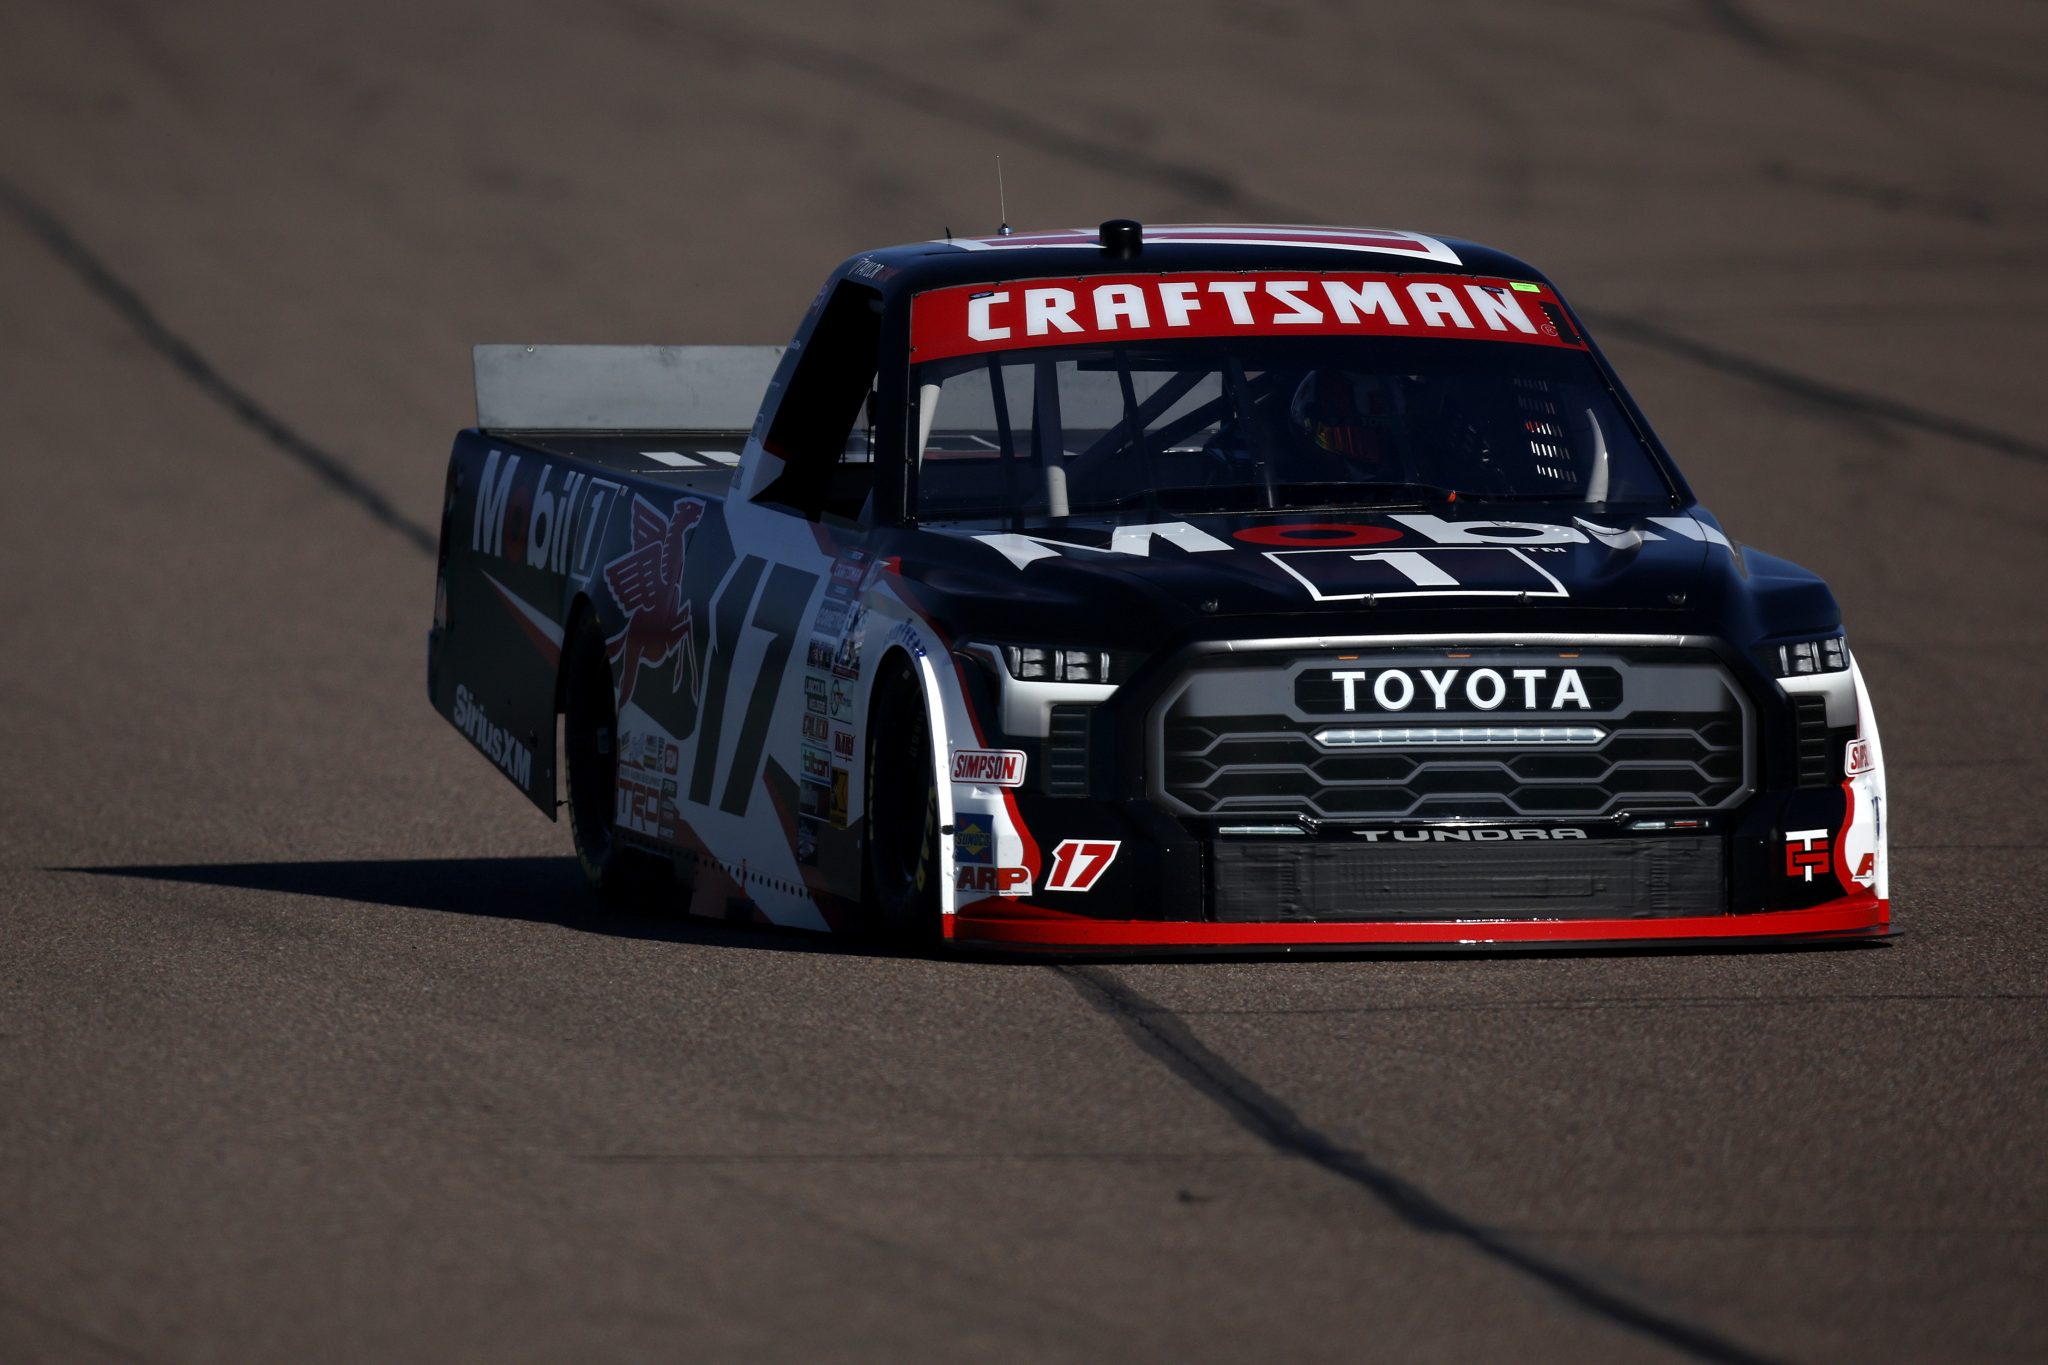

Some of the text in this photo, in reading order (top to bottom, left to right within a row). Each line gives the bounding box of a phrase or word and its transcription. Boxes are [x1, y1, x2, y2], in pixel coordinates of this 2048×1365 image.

[968, 280, 1539, 342] CRAFTSMAN
[472, 449, 586, 575] Mobil
[1350, 551, 1460, 586] 1
[688, 553, 821, 817] 17
[1332, 668, 1592, 711] TOYOTA
[453, 683, 532, 792] SiriusXM
[954, 754, 1017, 780] SIMPSON
[1352, 828, 1589, 842] TUNDRA
[956, 866, 1029, 891] ARP
[1046, 840, 1121, 891] 17
